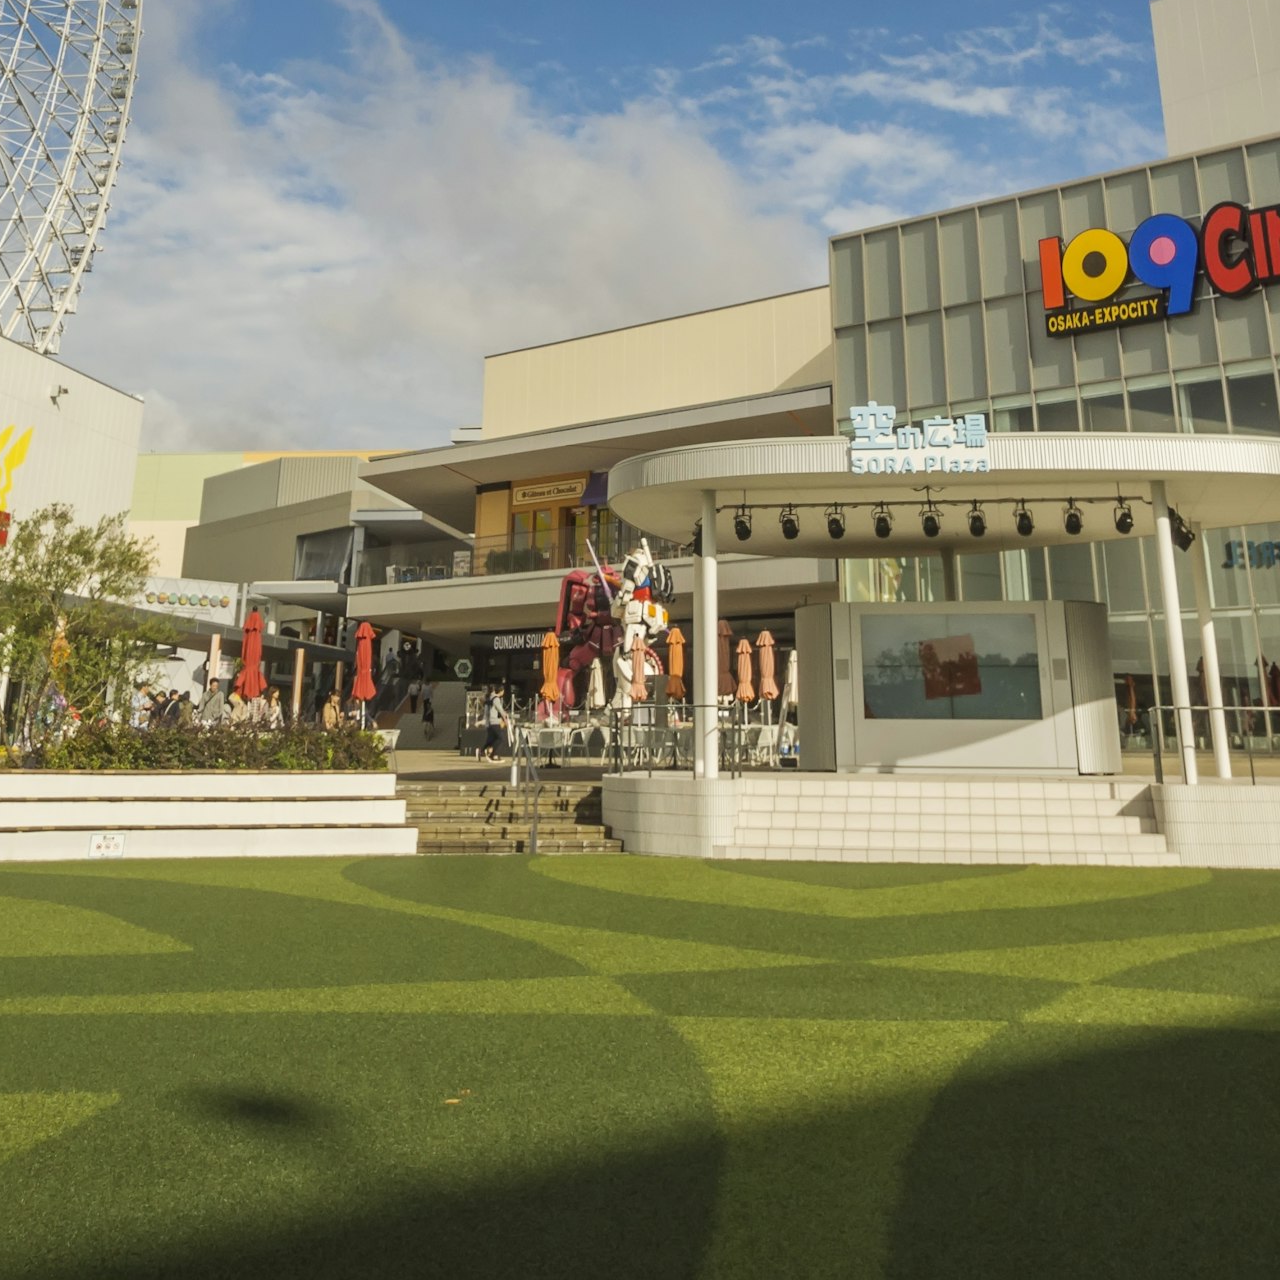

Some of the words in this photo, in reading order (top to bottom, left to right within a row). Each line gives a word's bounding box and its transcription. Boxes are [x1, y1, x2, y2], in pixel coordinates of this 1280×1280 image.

[1038, 213, 1199, 316] 109
[1048, 298, 1159, 334] OSAKA-EXPOCITY
[850, 401, 988, 450] 空の広場
[851, 455, 917, 475] SORA
[925, 455, 991, 474] Plaza
[493, 634, 525, 650] GUNDAM
